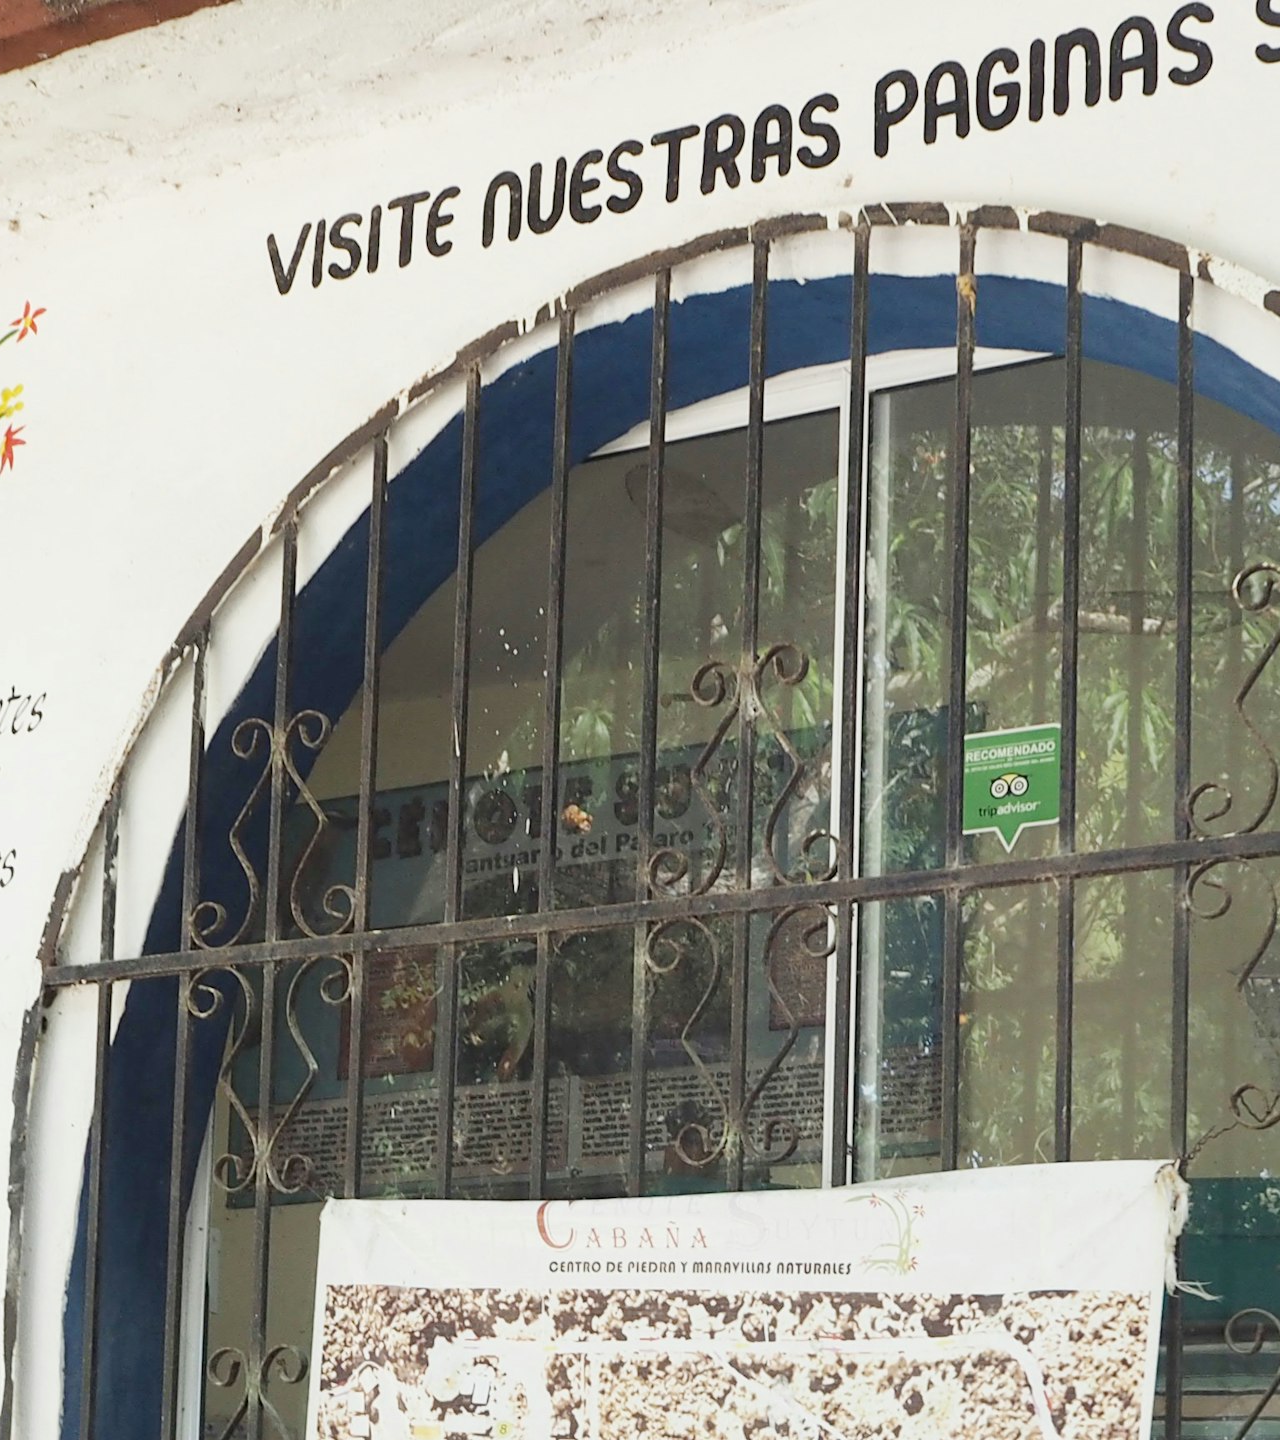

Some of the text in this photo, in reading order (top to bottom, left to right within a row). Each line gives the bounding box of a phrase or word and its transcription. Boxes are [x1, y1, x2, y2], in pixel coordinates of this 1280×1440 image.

[267, 186, 459, 295] VISITE
[481, 92, 841, 248] NUESTRAS
[873, 1, 1214, 158] PAGINAS
[966, 740, 1056, 763] RECOMENDADO
[978, 801, 1038, 818] tripadvisor
[571, 835, 608, 859] del
[615, 828, 694, 853] Paaro
[536, 1198, 709, 1251] CABAÑA
[548, 1260, 852, 1275] CENTRO DE PIEDRA Y MARAVILLAS NATURALES
[499, 1423, 508, 1435] 8
